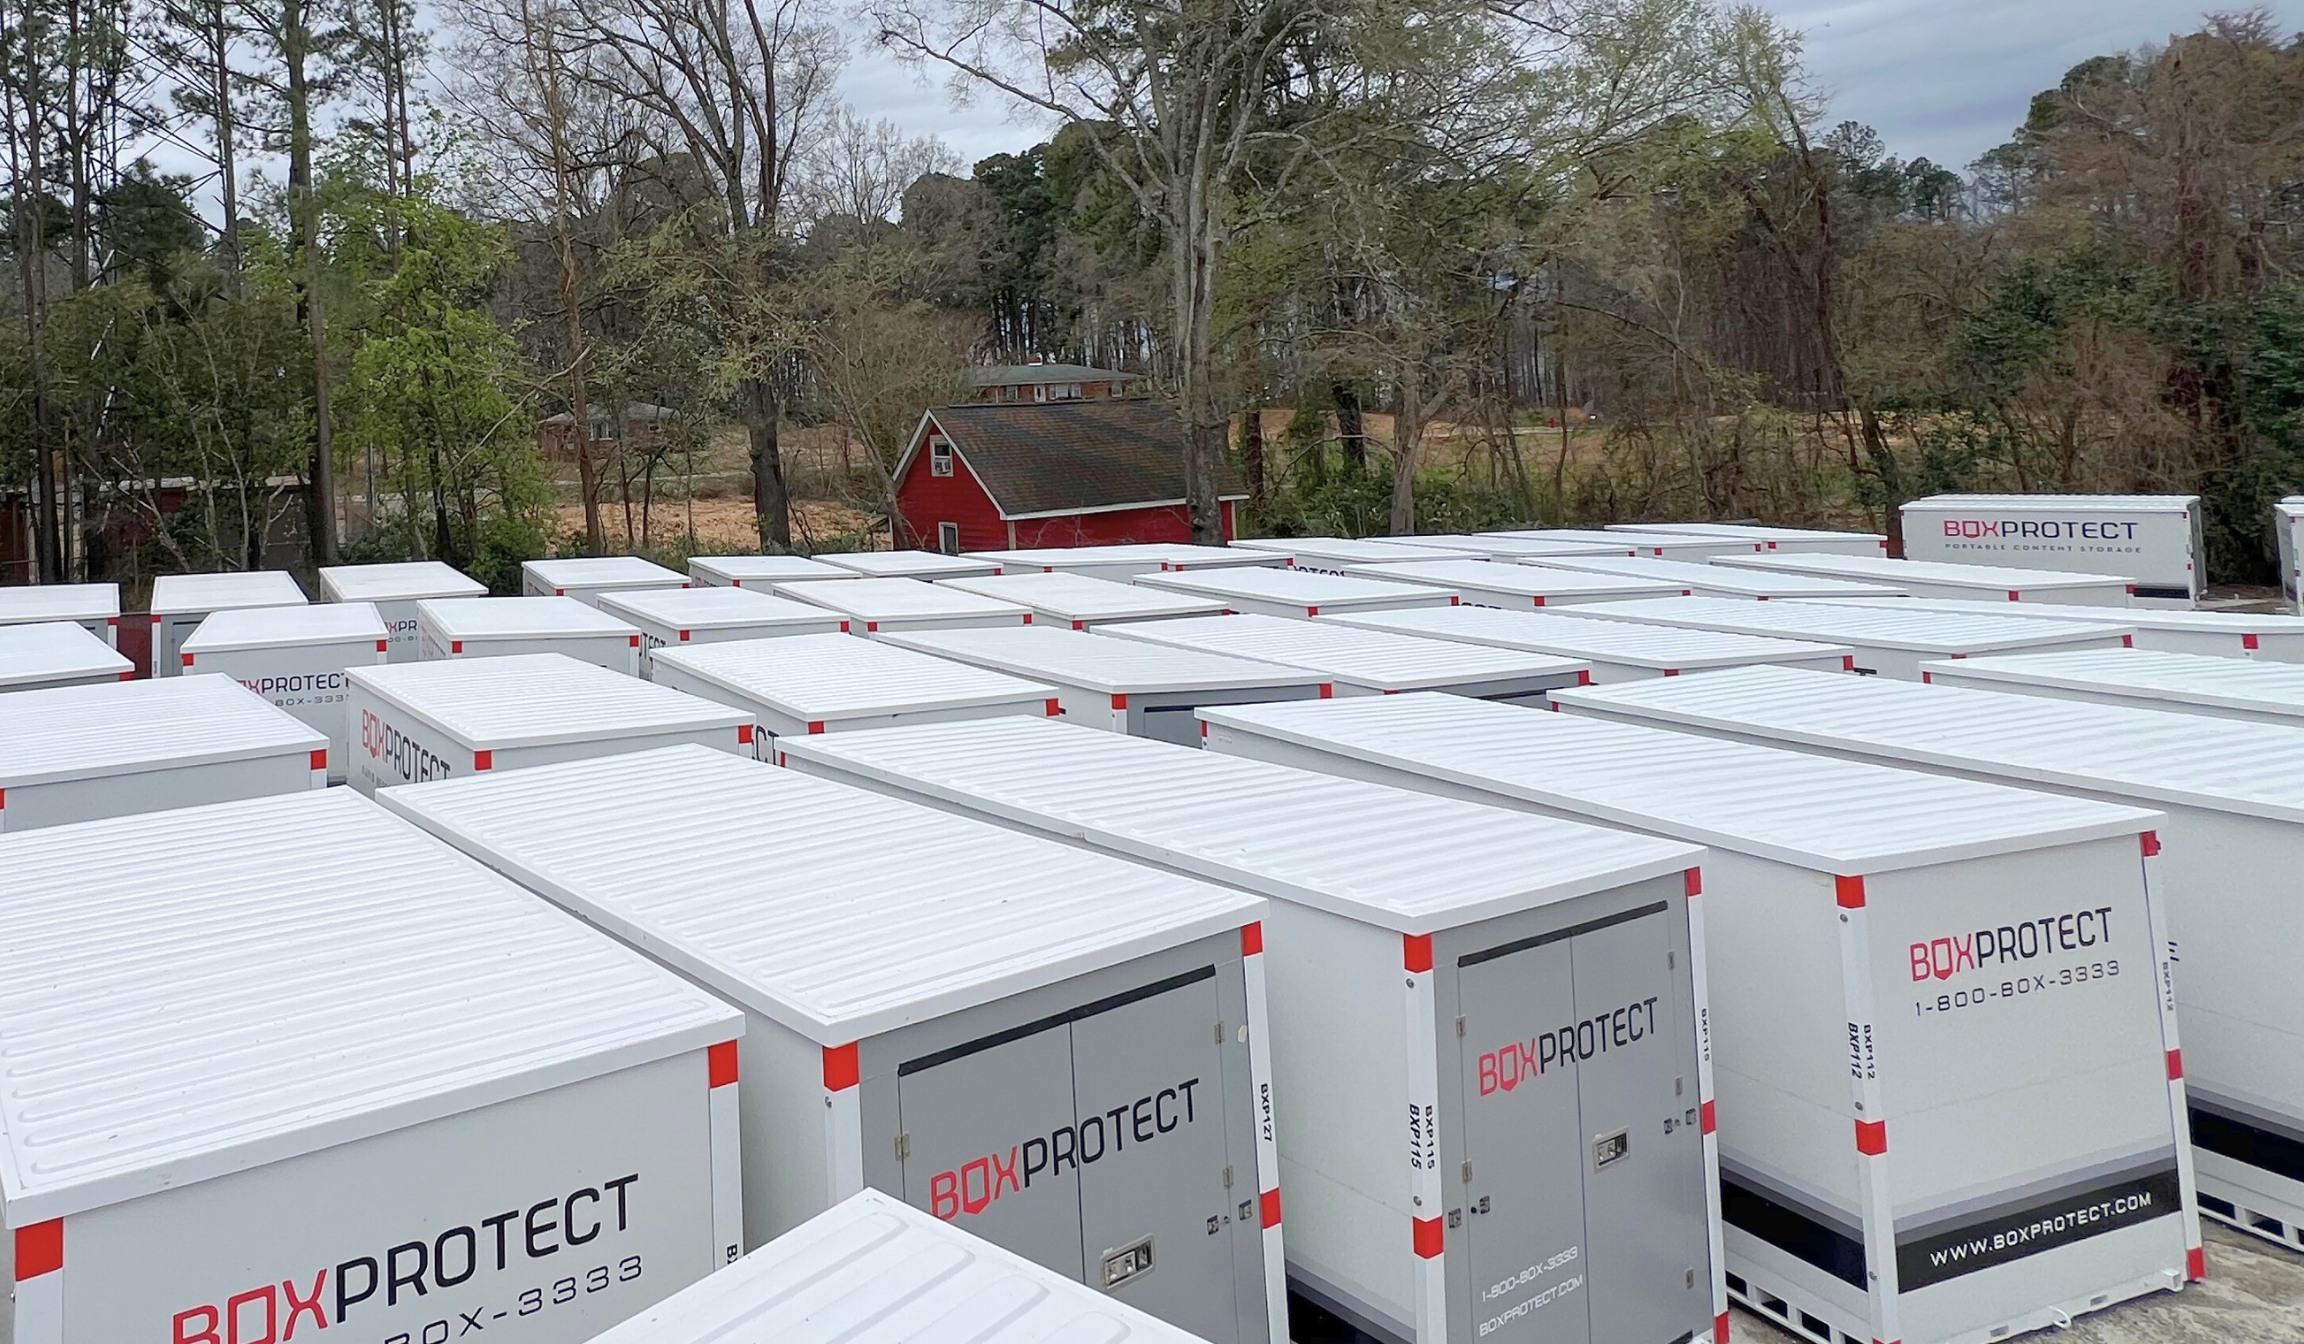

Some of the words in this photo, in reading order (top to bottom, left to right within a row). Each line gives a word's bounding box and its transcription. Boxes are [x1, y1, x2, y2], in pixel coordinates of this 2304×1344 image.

[1943, 520, 2139, 539] BOXPROTECT
[2014, 544, 2072, 552] CONTENT
[1909, 906, 2112, 982] BOXPROTECT
[1915, 959, 2120, 1017] 1-800-BOX-3333
[1478, 996, 1658, 1097] BOXPROTECT
[1847, 1022, 1863, 1079] BXP112
[1863, 1024, 1876, 1080] BXP112
[1260, 1083, 1273, 1142] BXP127
[1409, 1103, 1422, 1170] BXP115
[1425, 1104, 1435, 1170] BXP115
[930, 1077, 1200, 1222] BOXPROTECT
[1929, 1191, 2153, 1268] WWW.BOXPROTECT.COM
[1481, 1245, 1579, 1303] 1-800-BOX-3333
[1479, 1273, 1584, 1338] BOXPROTECT.COM
